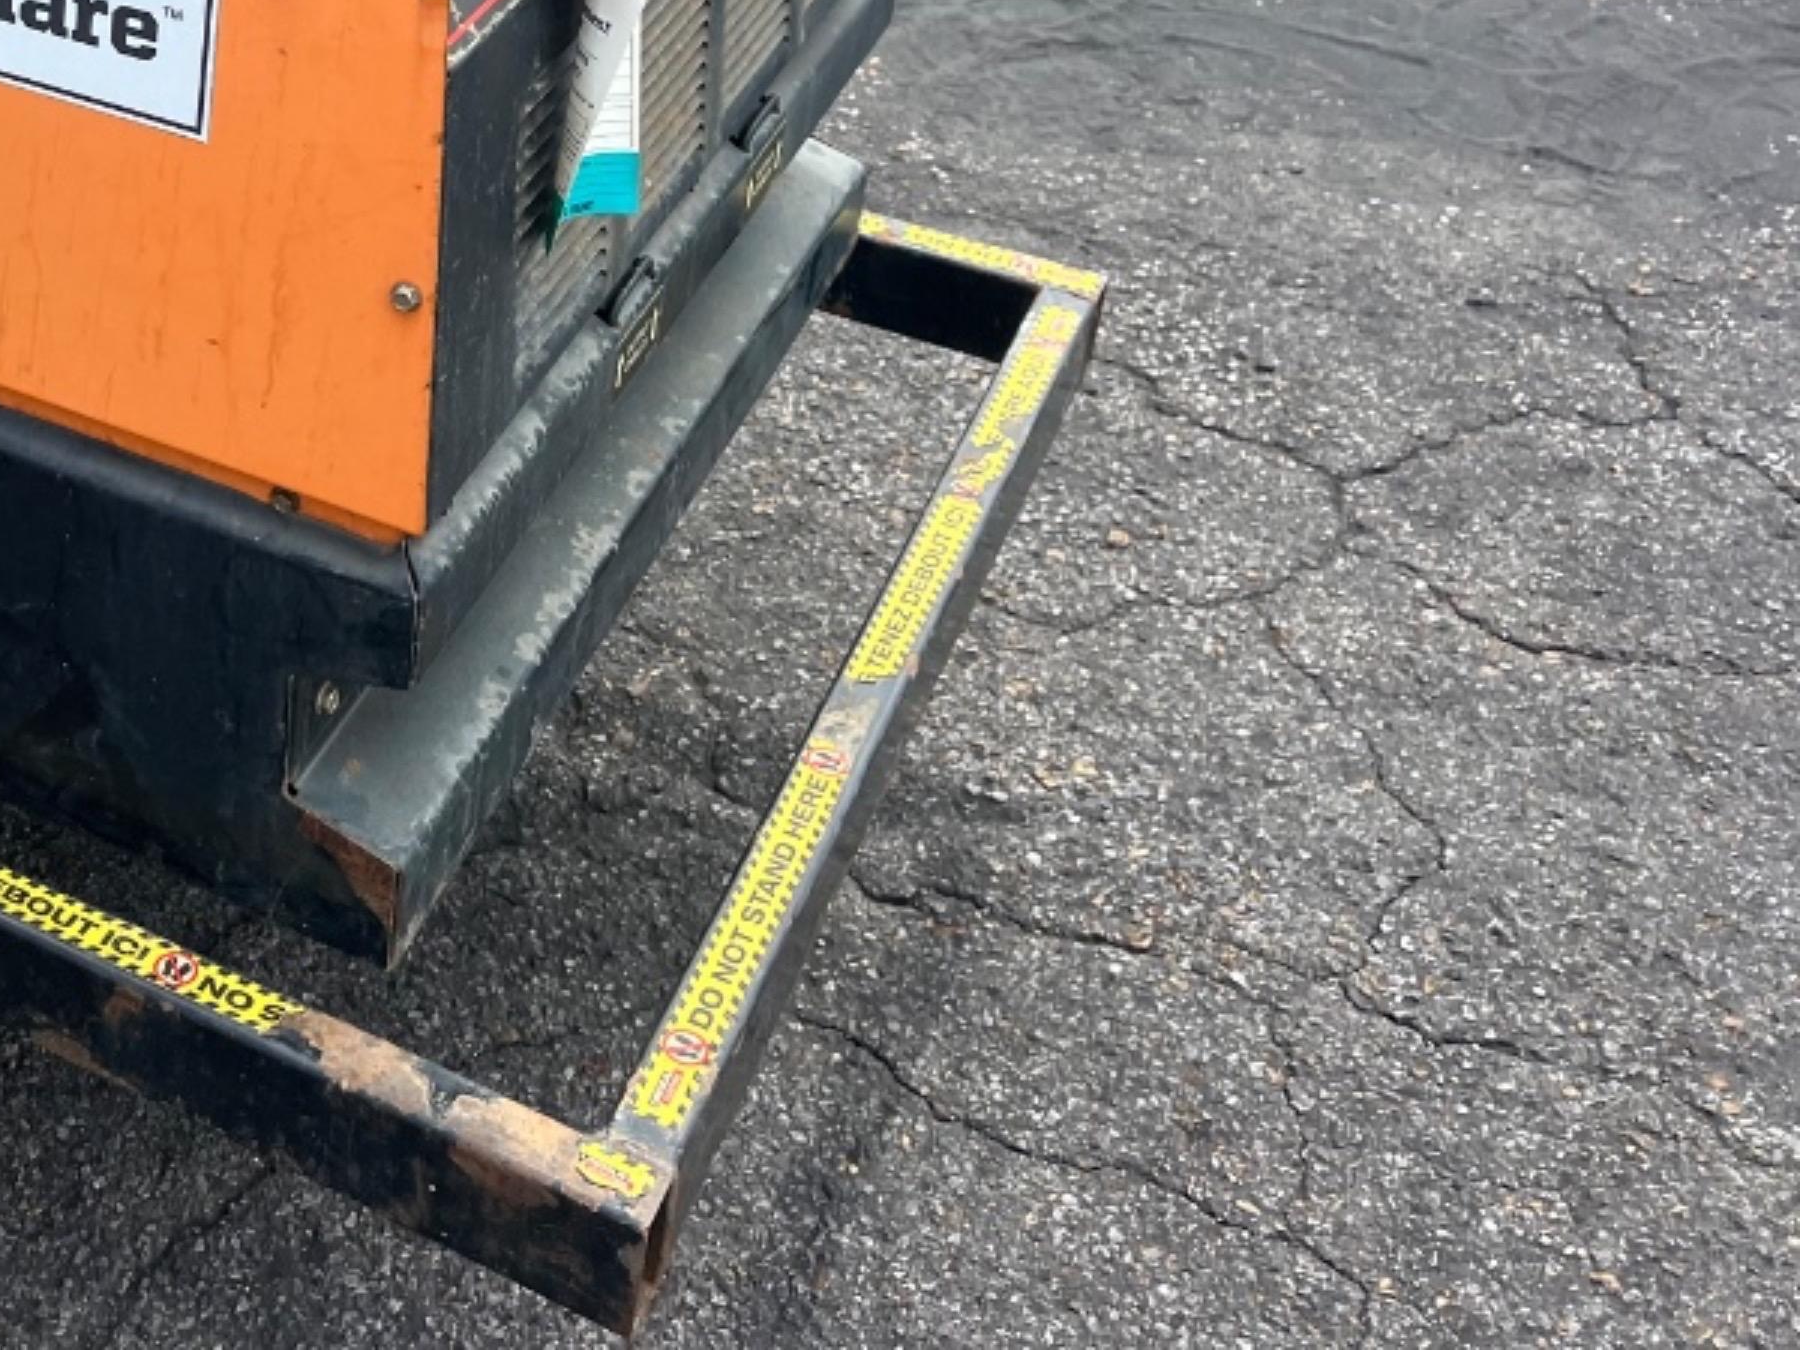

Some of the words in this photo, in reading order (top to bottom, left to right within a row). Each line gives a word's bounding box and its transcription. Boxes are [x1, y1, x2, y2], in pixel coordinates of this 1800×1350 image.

[866, 607, 912, 671] TENEZ
[900, 532, 952, 607] DEBOUT
[99, 930, 150, 961] ICI
[687, 986, 725, 1030] DO
[711, 925, 754, 985] NOT
[740, 841, 798, 925] STAND
[783, 773, 830, 840] HERE
[198, 976, 254, 1010] NO
[258, 1003, 286, 1022] S
